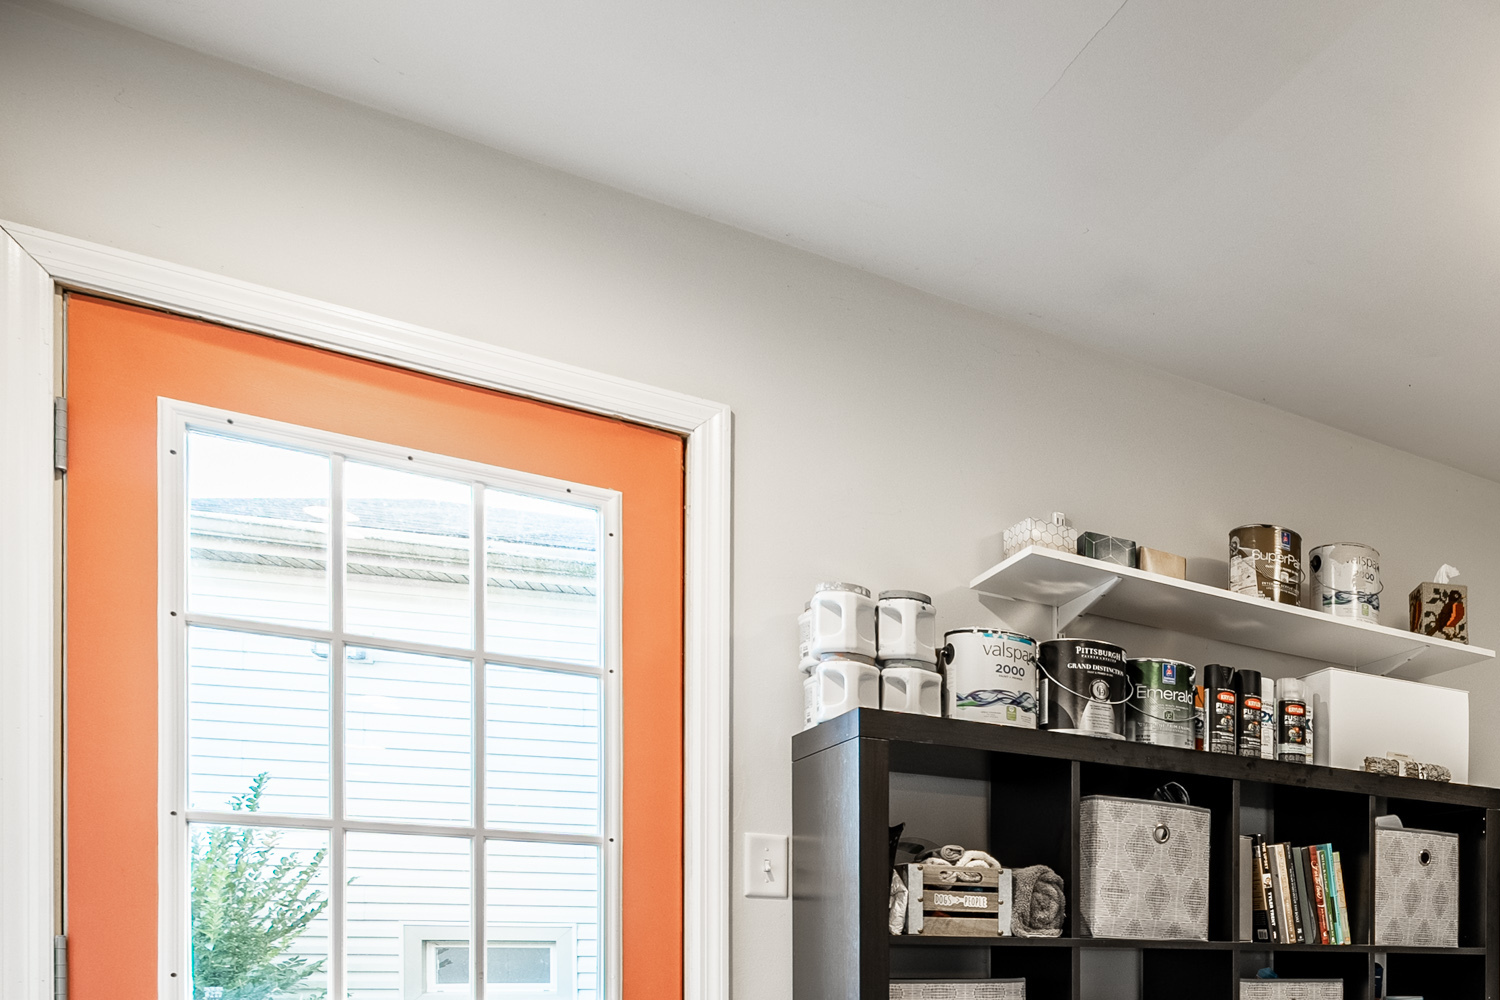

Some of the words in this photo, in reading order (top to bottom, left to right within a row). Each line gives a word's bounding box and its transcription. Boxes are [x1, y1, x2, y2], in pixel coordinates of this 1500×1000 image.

[1075, 646, 1121, 661] PITTSBURGH
[995, 664, 1025, 677] 2000
[1136, 685, 1194, 705] Emerald
[935, 893, 952, 905] DOGS
[964, 895, 987, 907] PEOPLE
